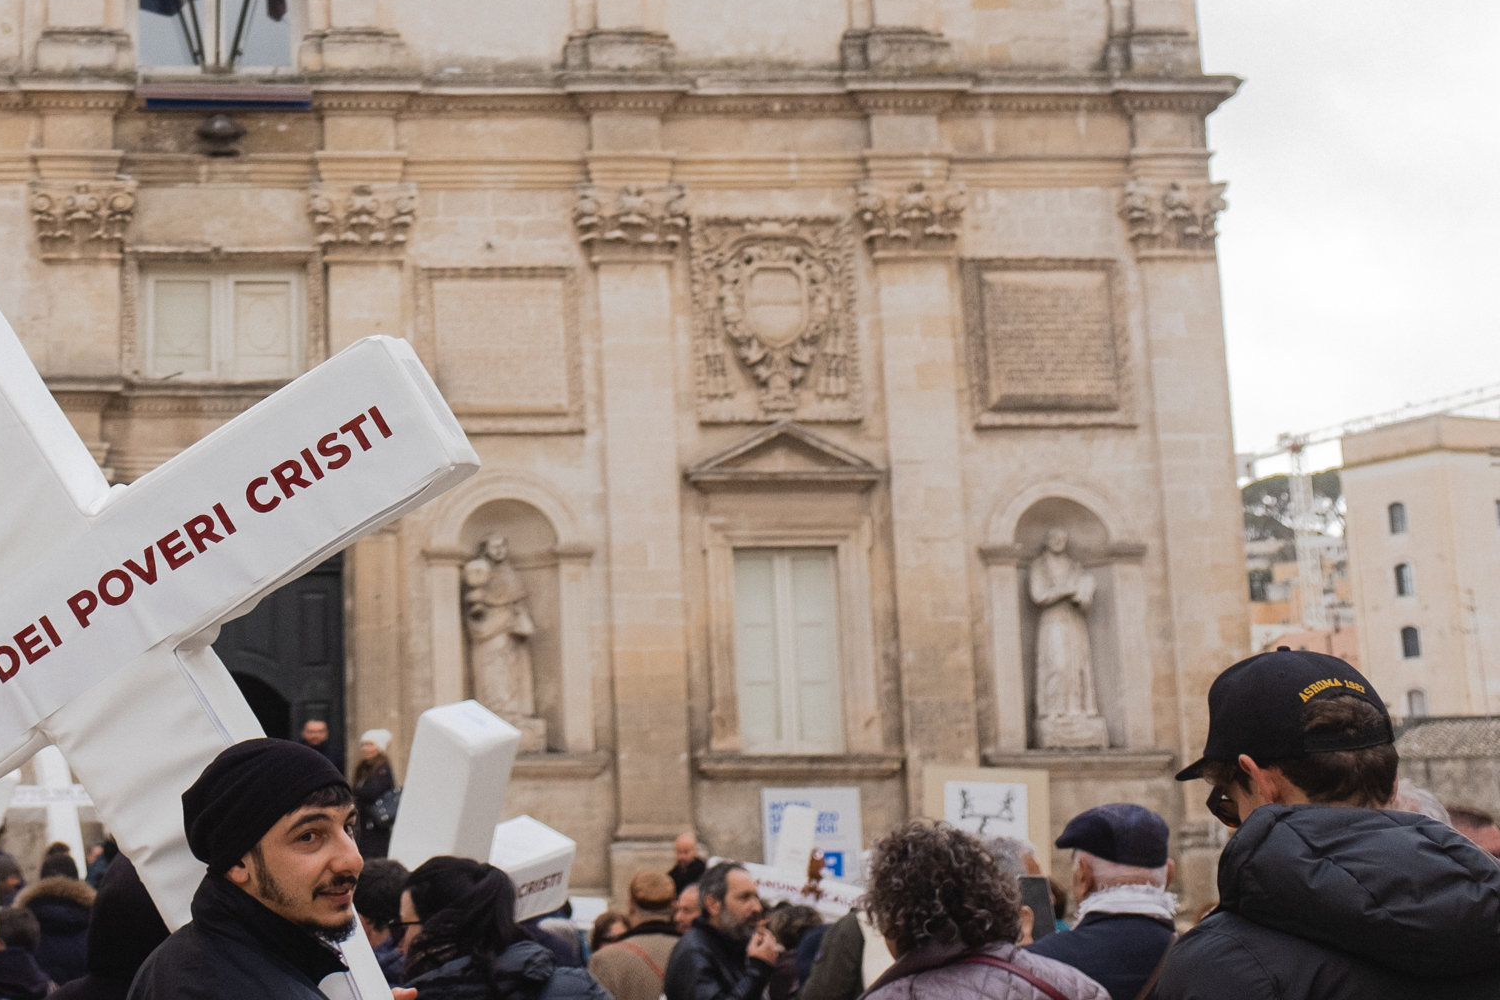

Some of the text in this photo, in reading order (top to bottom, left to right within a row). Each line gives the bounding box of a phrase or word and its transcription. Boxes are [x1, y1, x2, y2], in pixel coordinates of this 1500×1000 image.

[66, 502, 237, 628] POVERI
[245, 405, 393, 513] CRISTI
[1344, 680, 1366, 694] 1927
